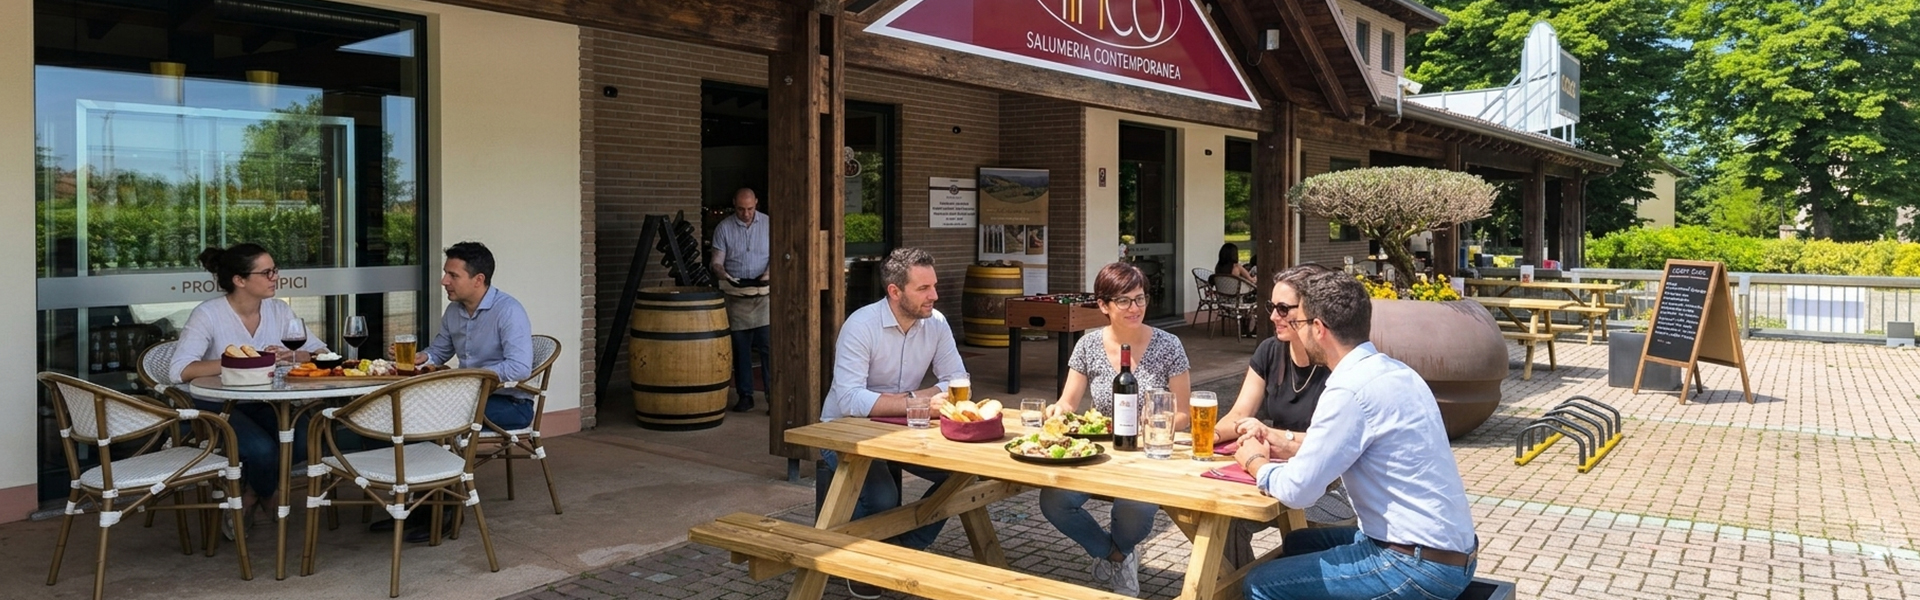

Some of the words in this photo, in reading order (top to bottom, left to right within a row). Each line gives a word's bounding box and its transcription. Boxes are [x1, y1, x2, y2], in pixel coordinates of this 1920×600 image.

[1026, 31, 1091, 61] SALUMERIA
[1094, 49, 1181, 80] CONTEMPORANEA
[275, 276, 307, 290] IPICI
